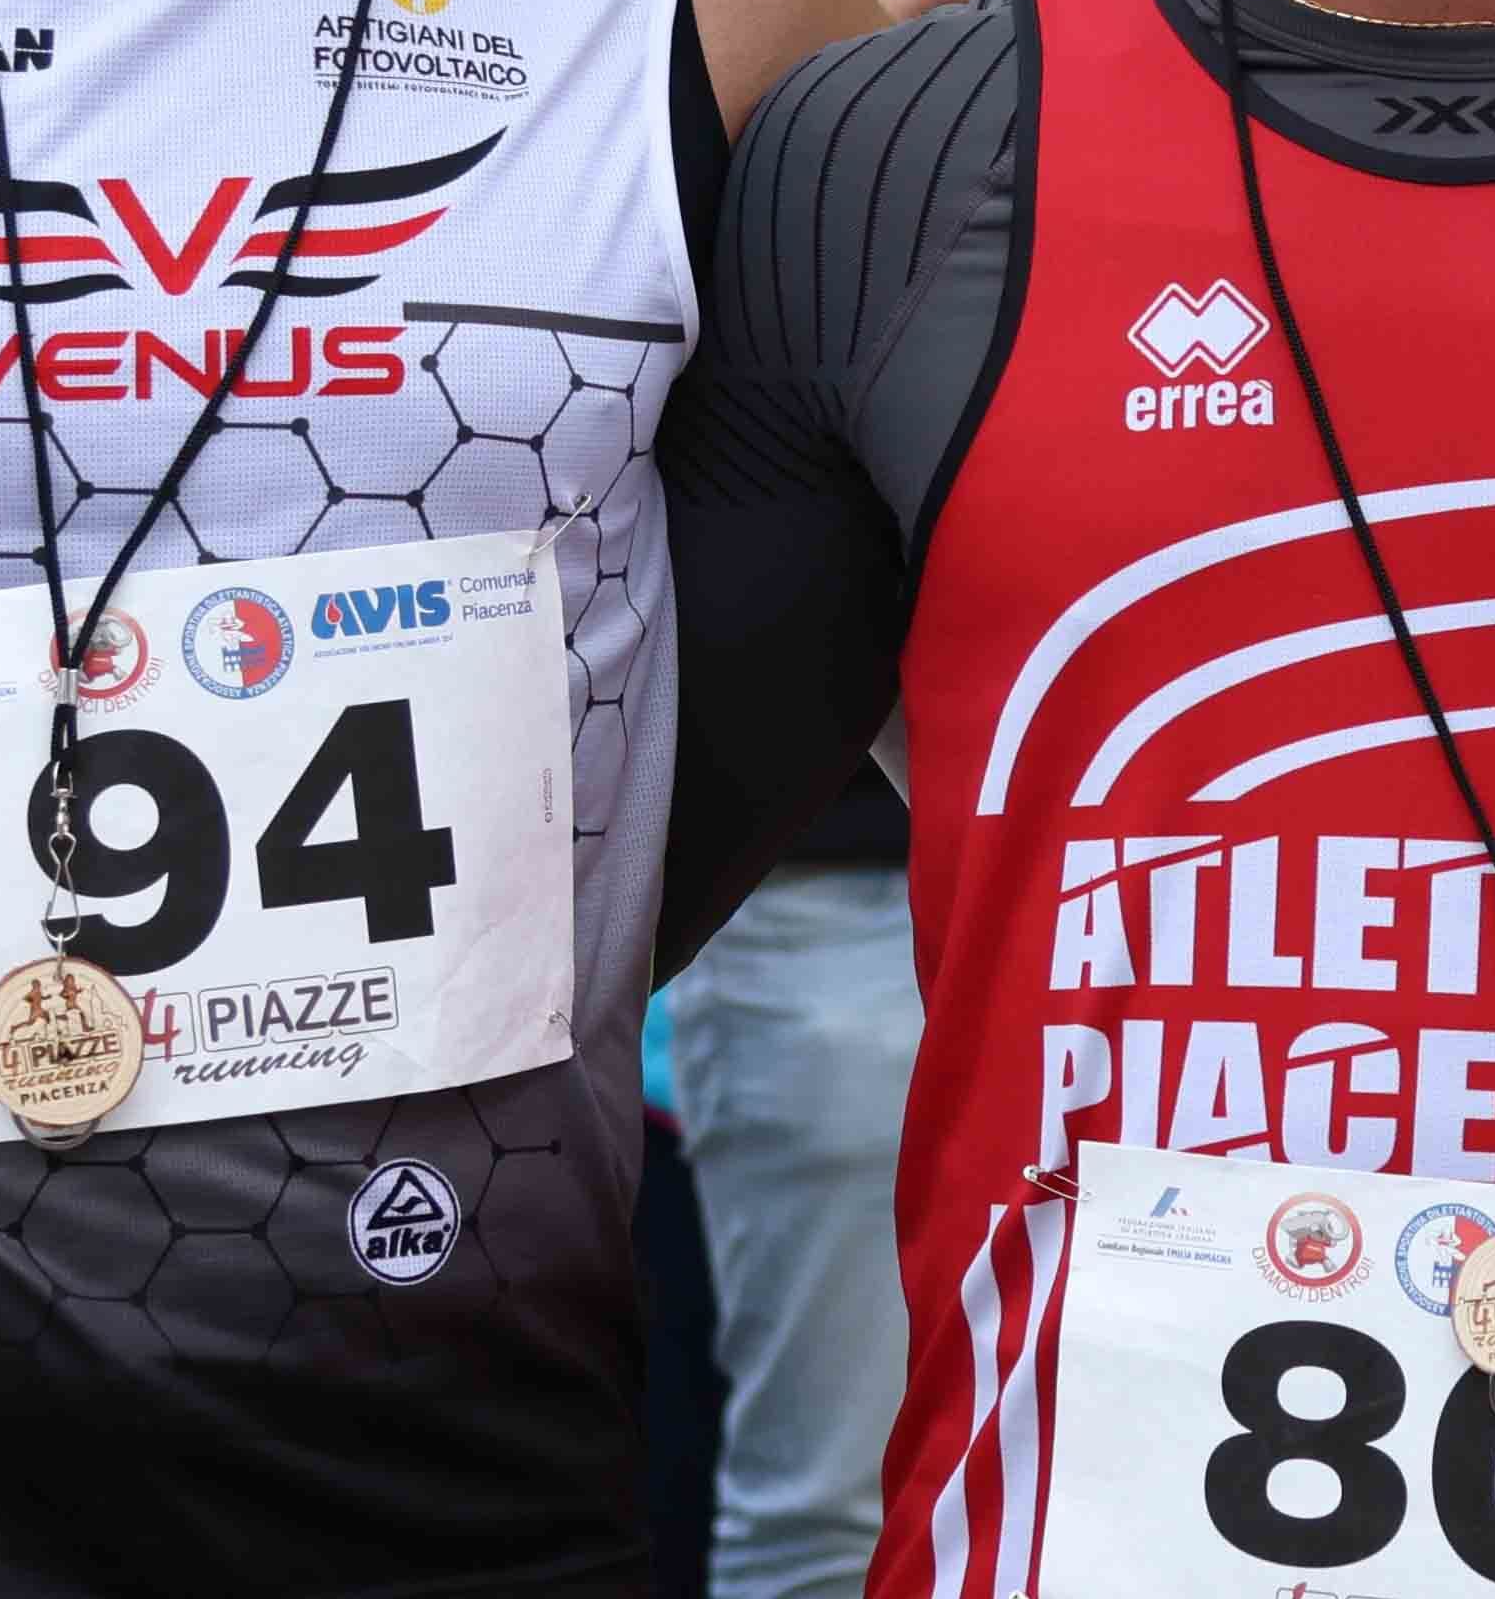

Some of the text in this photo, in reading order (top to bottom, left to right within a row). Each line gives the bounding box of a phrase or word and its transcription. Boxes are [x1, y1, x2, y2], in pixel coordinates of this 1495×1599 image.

[315, 13, 524, 61] ARTIGIANI DEL
[313, 46, 528, 87] FOTOVOLTAICO
[458, 568, 537, 595] Comunale
[311, 579, 452, 640] AVIS
[462, 600, 534, 623] Piacenza
[26, 697, 457, 977] 94
[206, 976, 394, 1043] PIAZZE
[31, 1035, 120, 1068] PIAZZE
[173, 1040, 371, 1086] running
[19, 1081, 110, 1106] PIACENZA
